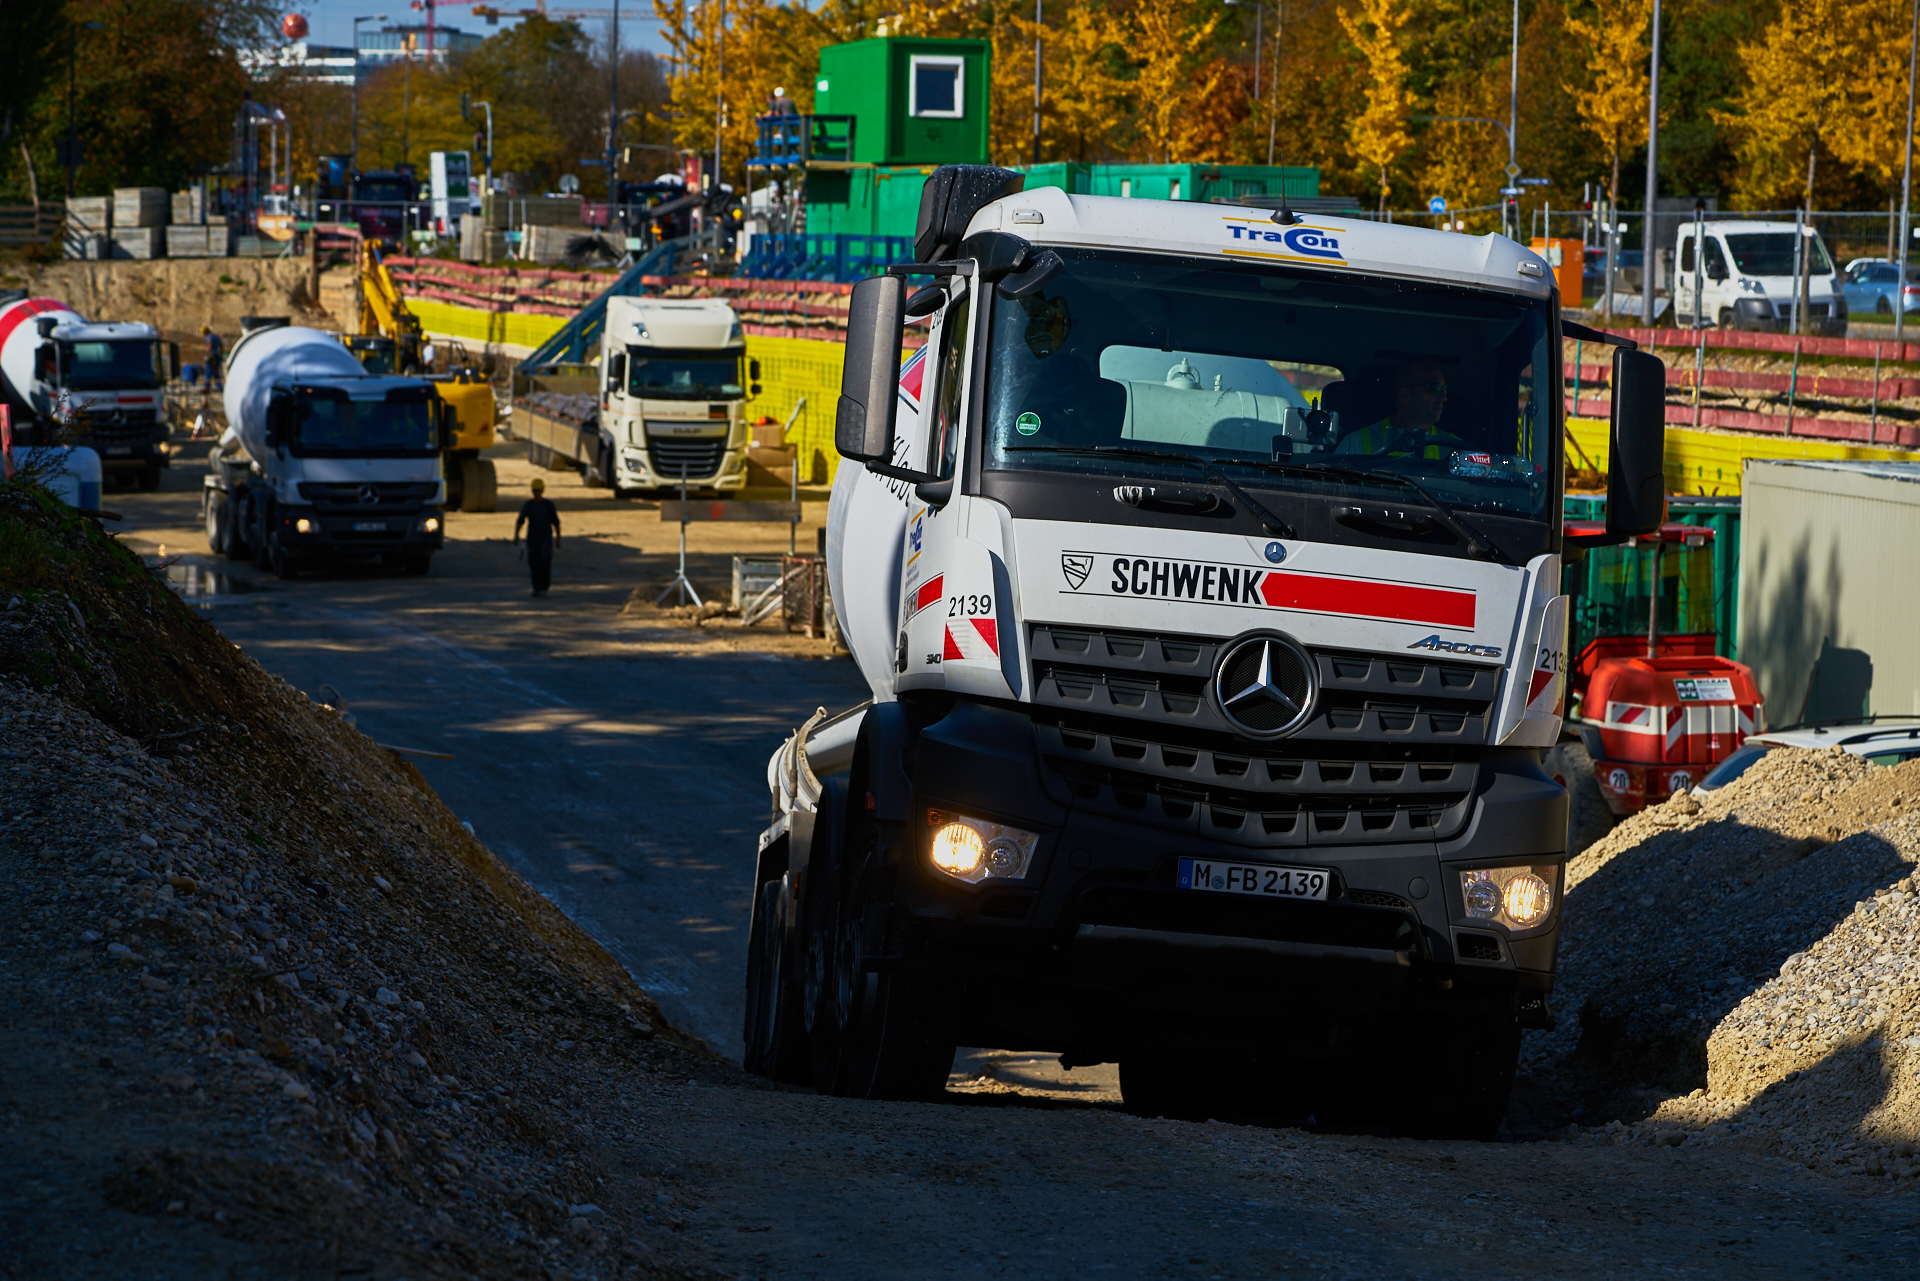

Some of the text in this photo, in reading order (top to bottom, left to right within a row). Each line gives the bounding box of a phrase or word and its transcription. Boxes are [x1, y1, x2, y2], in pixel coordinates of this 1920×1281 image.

[1226, 225, 1344, 259] TraCon
[1025, 414, 1032, 424] 4
[1472, 454, 1490, 464] Vittel
[1111, 558, 1263, 605] SCHWENK
[948, 594, 992, 617] 2139
[1612, 772, 1626, 788] 20
[1673, 774, 1689, 793] 20
[1194, 863, 1324, 898] M FB 2139
